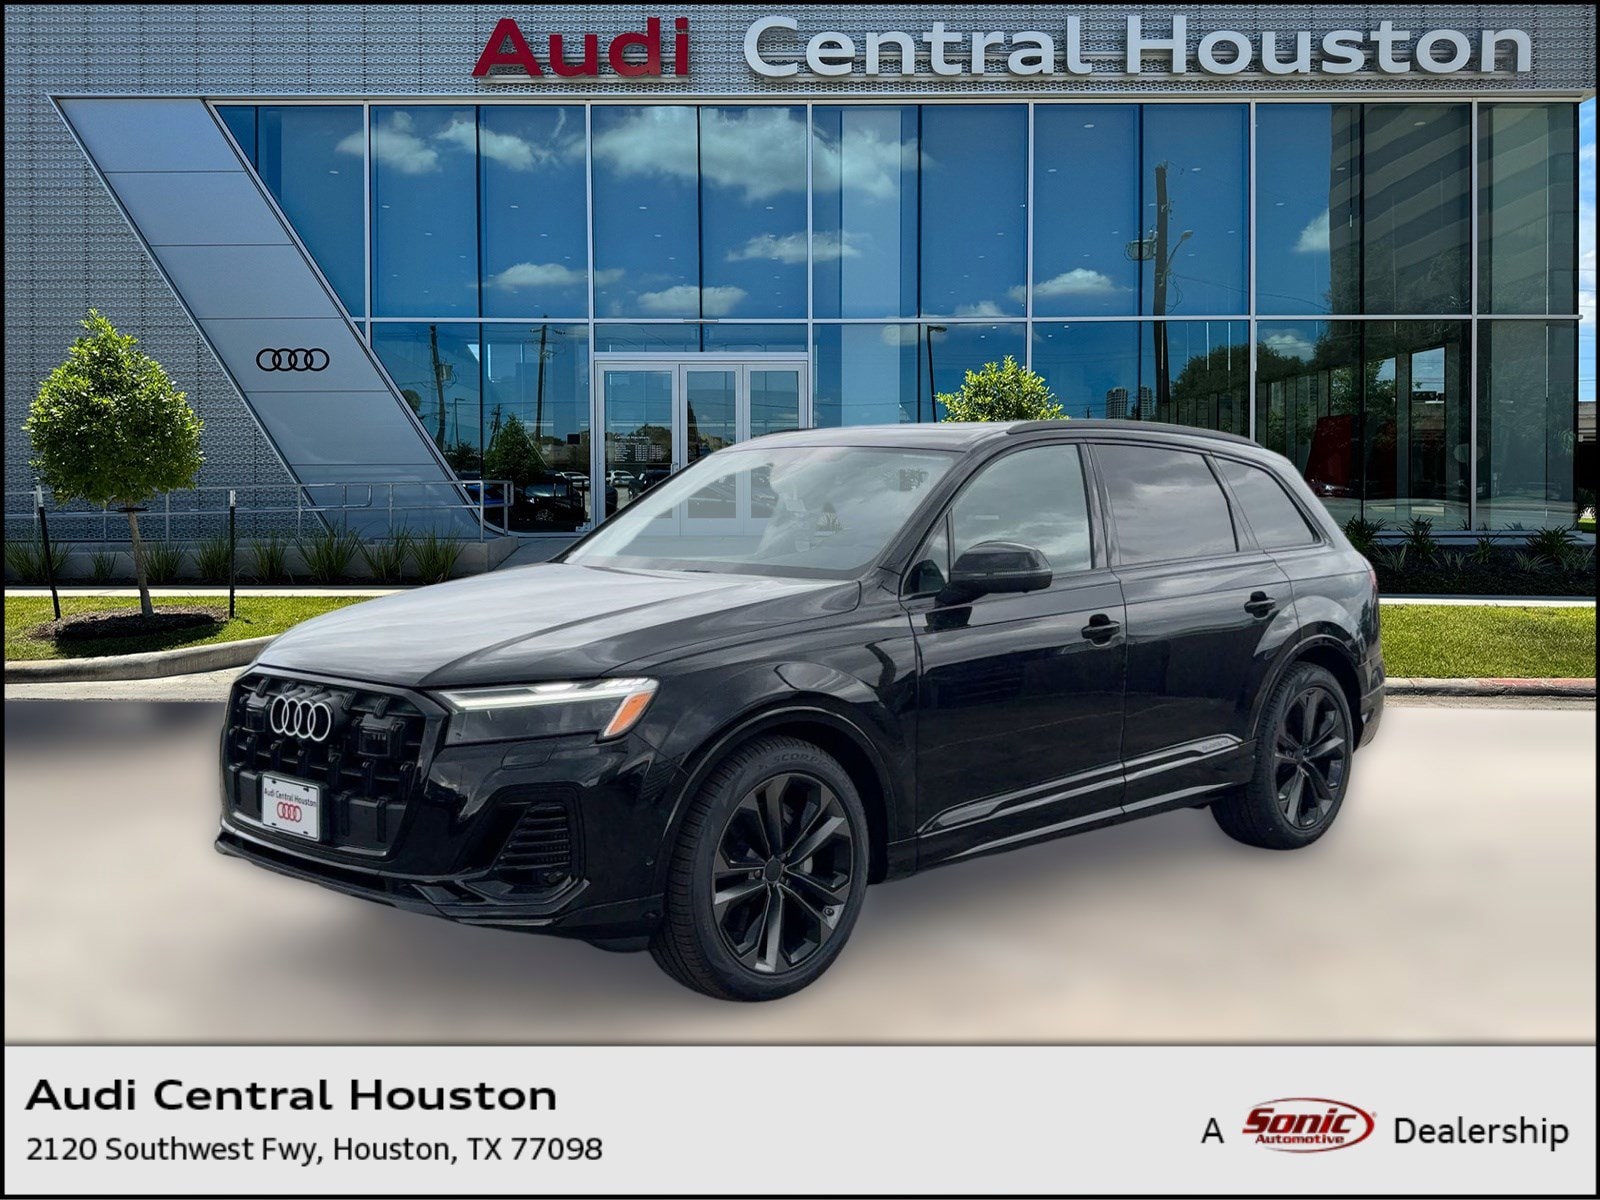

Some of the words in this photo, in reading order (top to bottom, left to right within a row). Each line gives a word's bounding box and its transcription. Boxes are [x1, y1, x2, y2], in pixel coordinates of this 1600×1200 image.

[472, 17, 691, 78] Audi
[743, 15, 1093, 78] Central
[1126, 14, 1533, 76] Houston
[264, 787, 275, 797] Audi
[275, 790, 293, 802] Central
[294, 795, 317, 807] Houston
